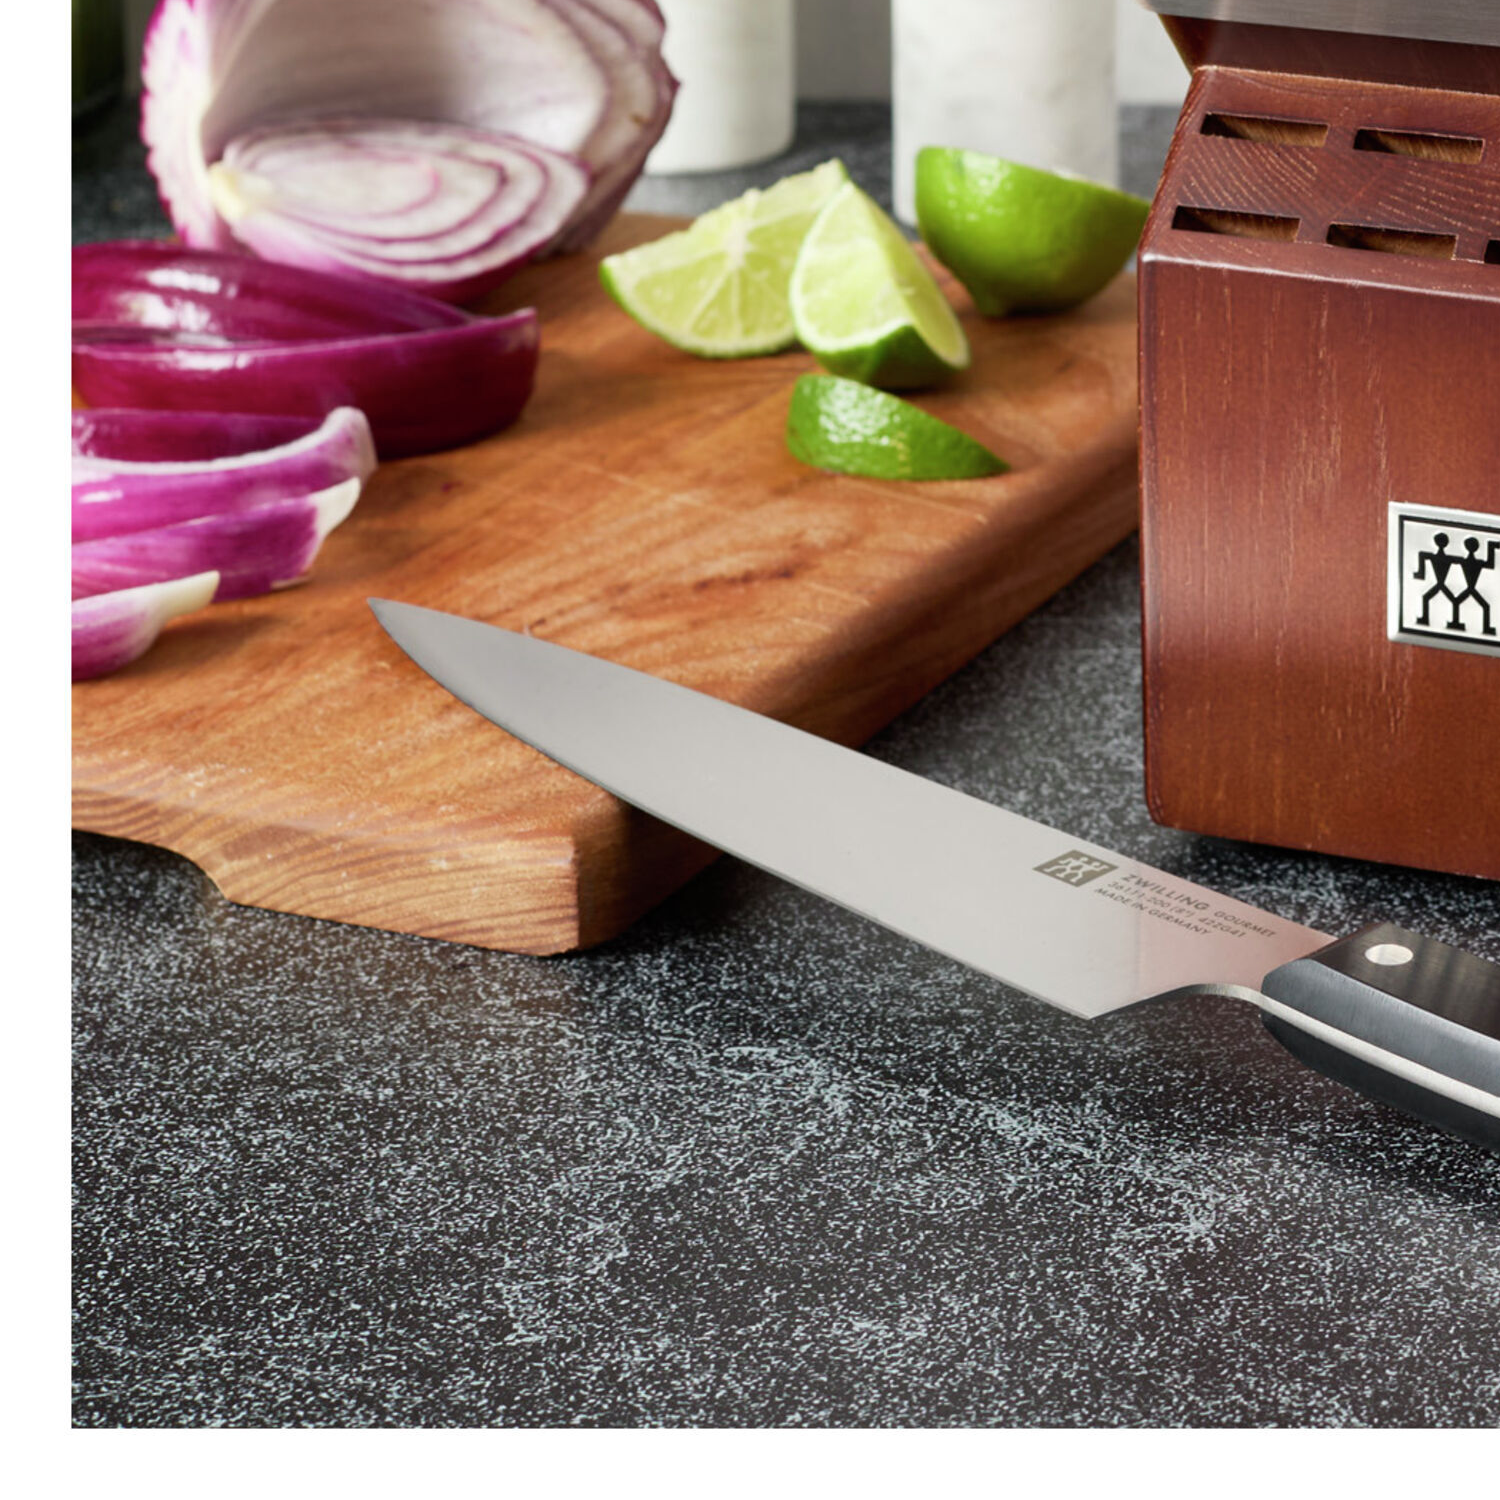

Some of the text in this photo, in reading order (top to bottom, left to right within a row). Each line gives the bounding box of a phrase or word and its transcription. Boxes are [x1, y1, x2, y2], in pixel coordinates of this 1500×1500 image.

[1094, 888, 1213, 935] MADE IN GERMANY
[1121, 874, 1276, 937] ZWILLING GOURMET
